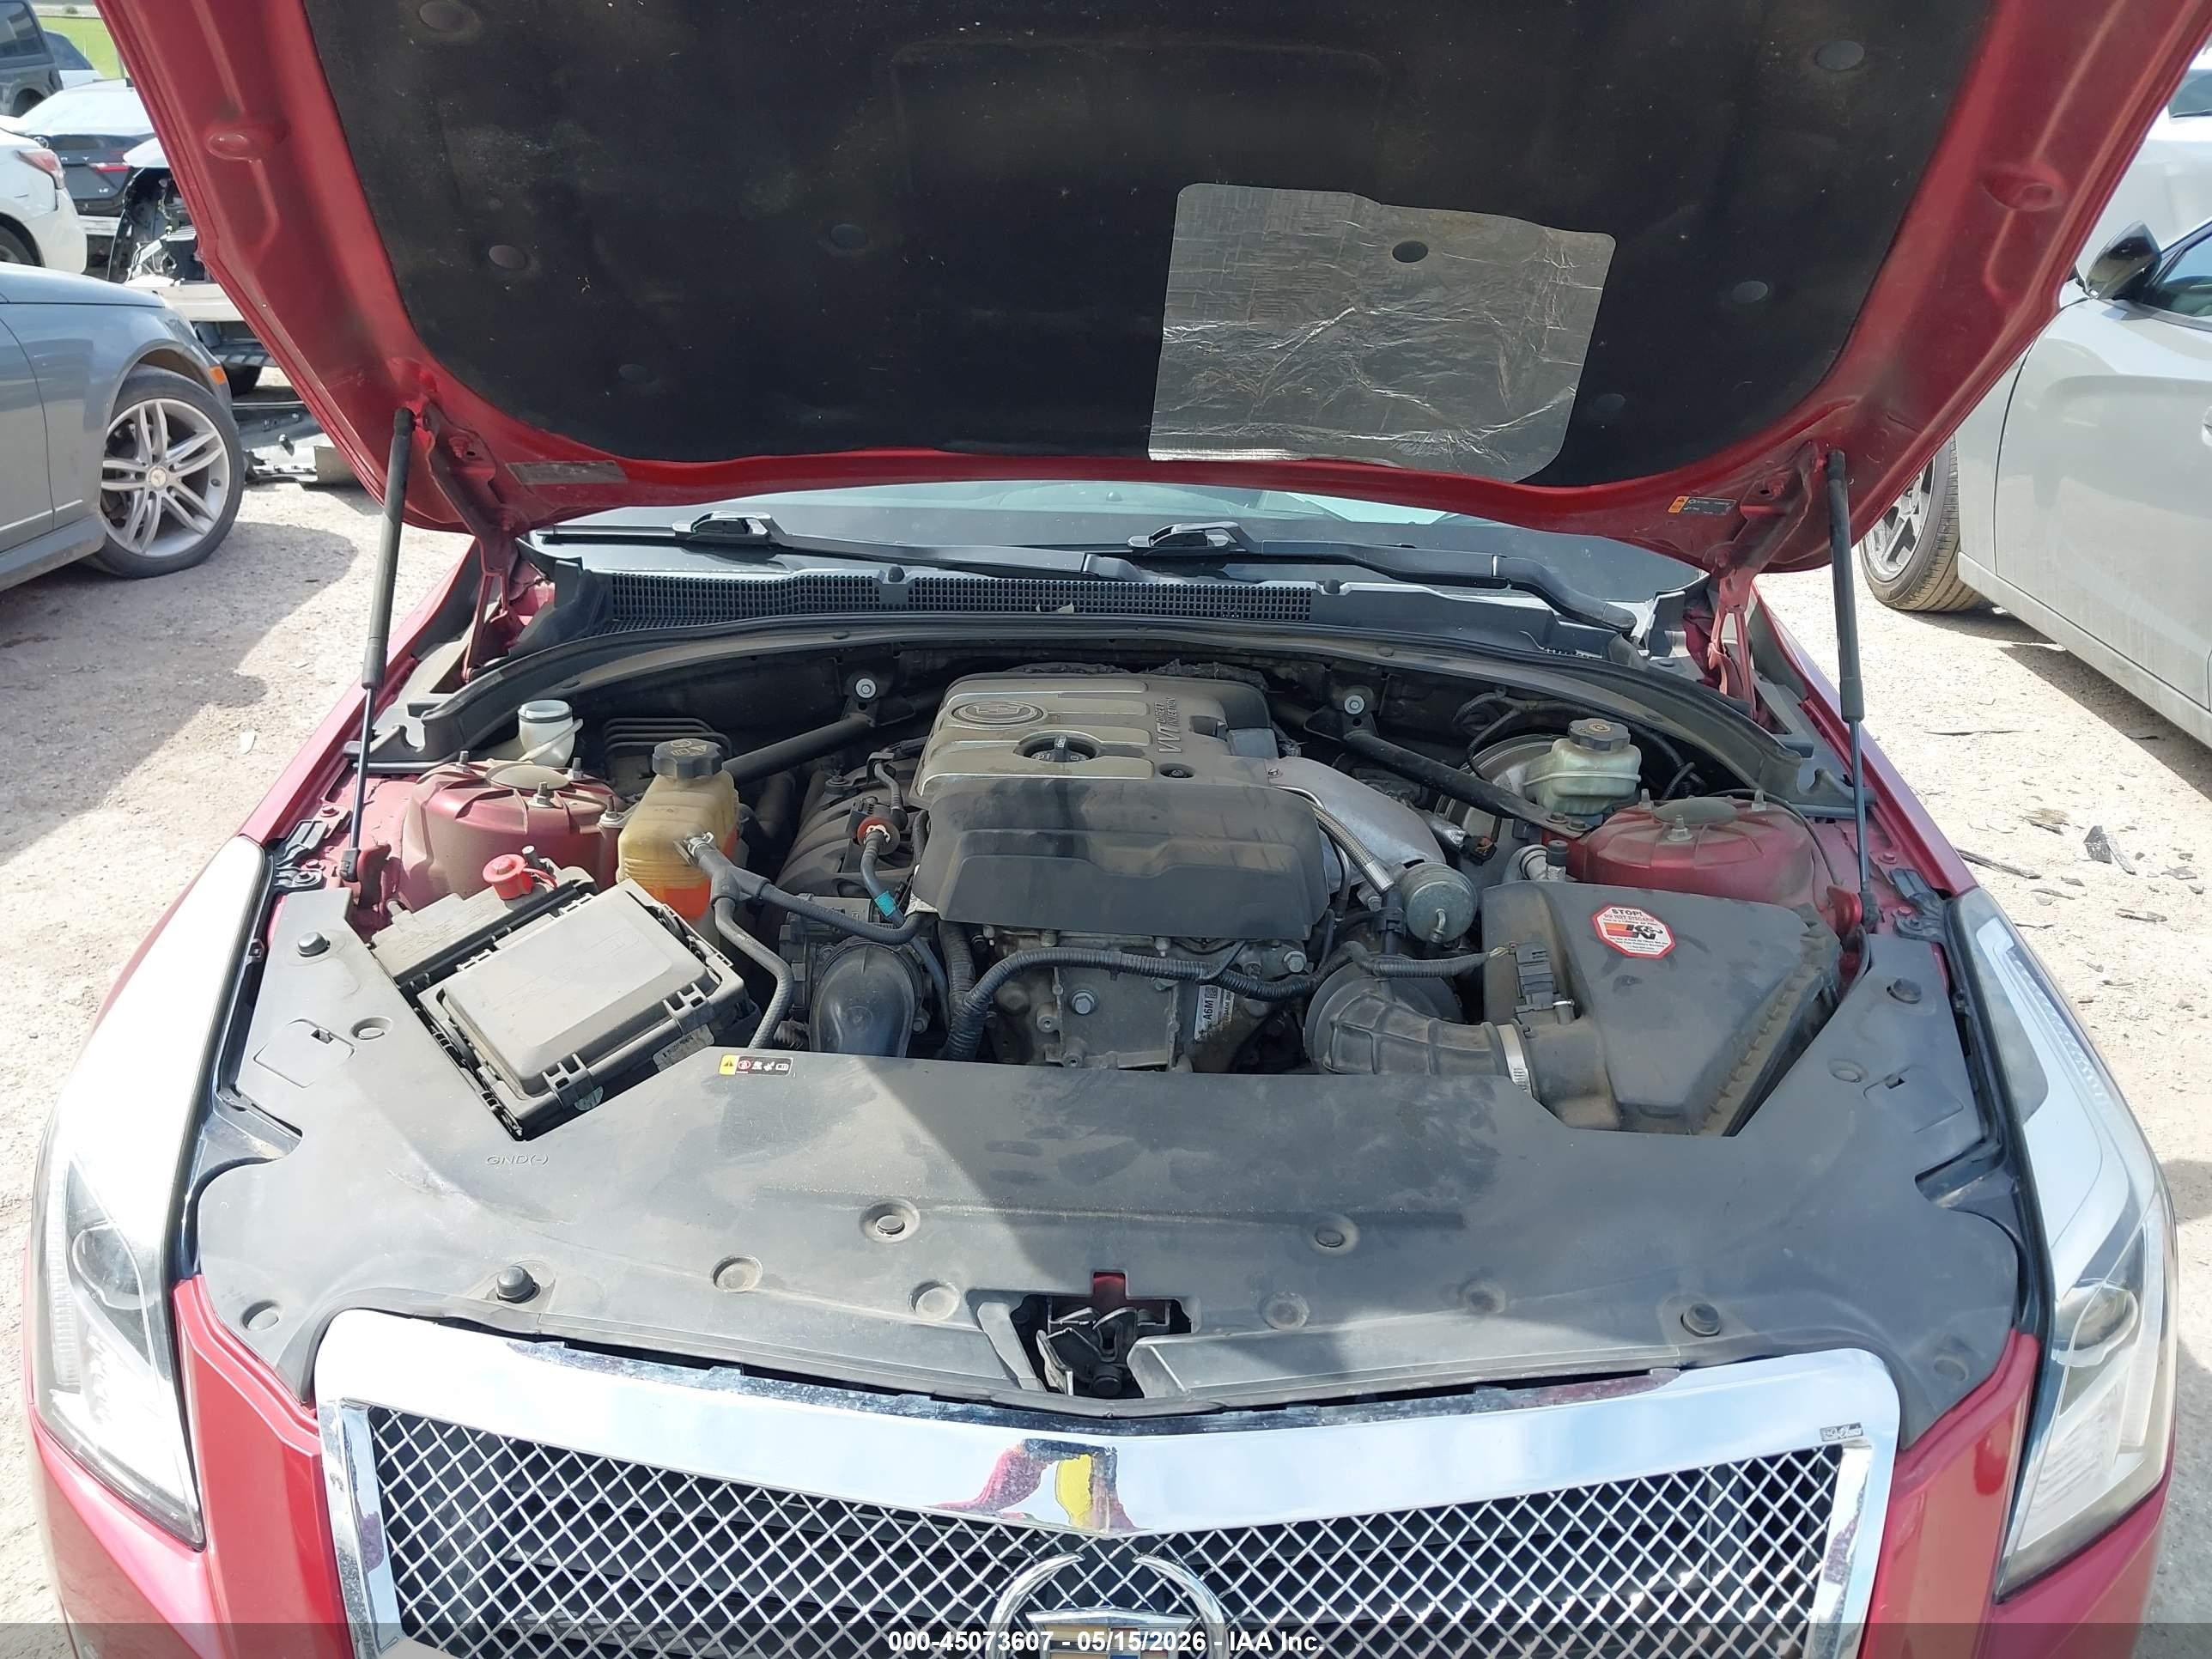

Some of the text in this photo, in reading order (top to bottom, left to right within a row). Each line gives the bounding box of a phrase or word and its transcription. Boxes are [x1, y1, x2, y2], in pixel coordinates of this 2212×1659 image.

[1157, 723, 1182, 753] VVT
[1203, 999, 1214, 1020] A6M
[487, 1154, 549, 1165] GND(-)
